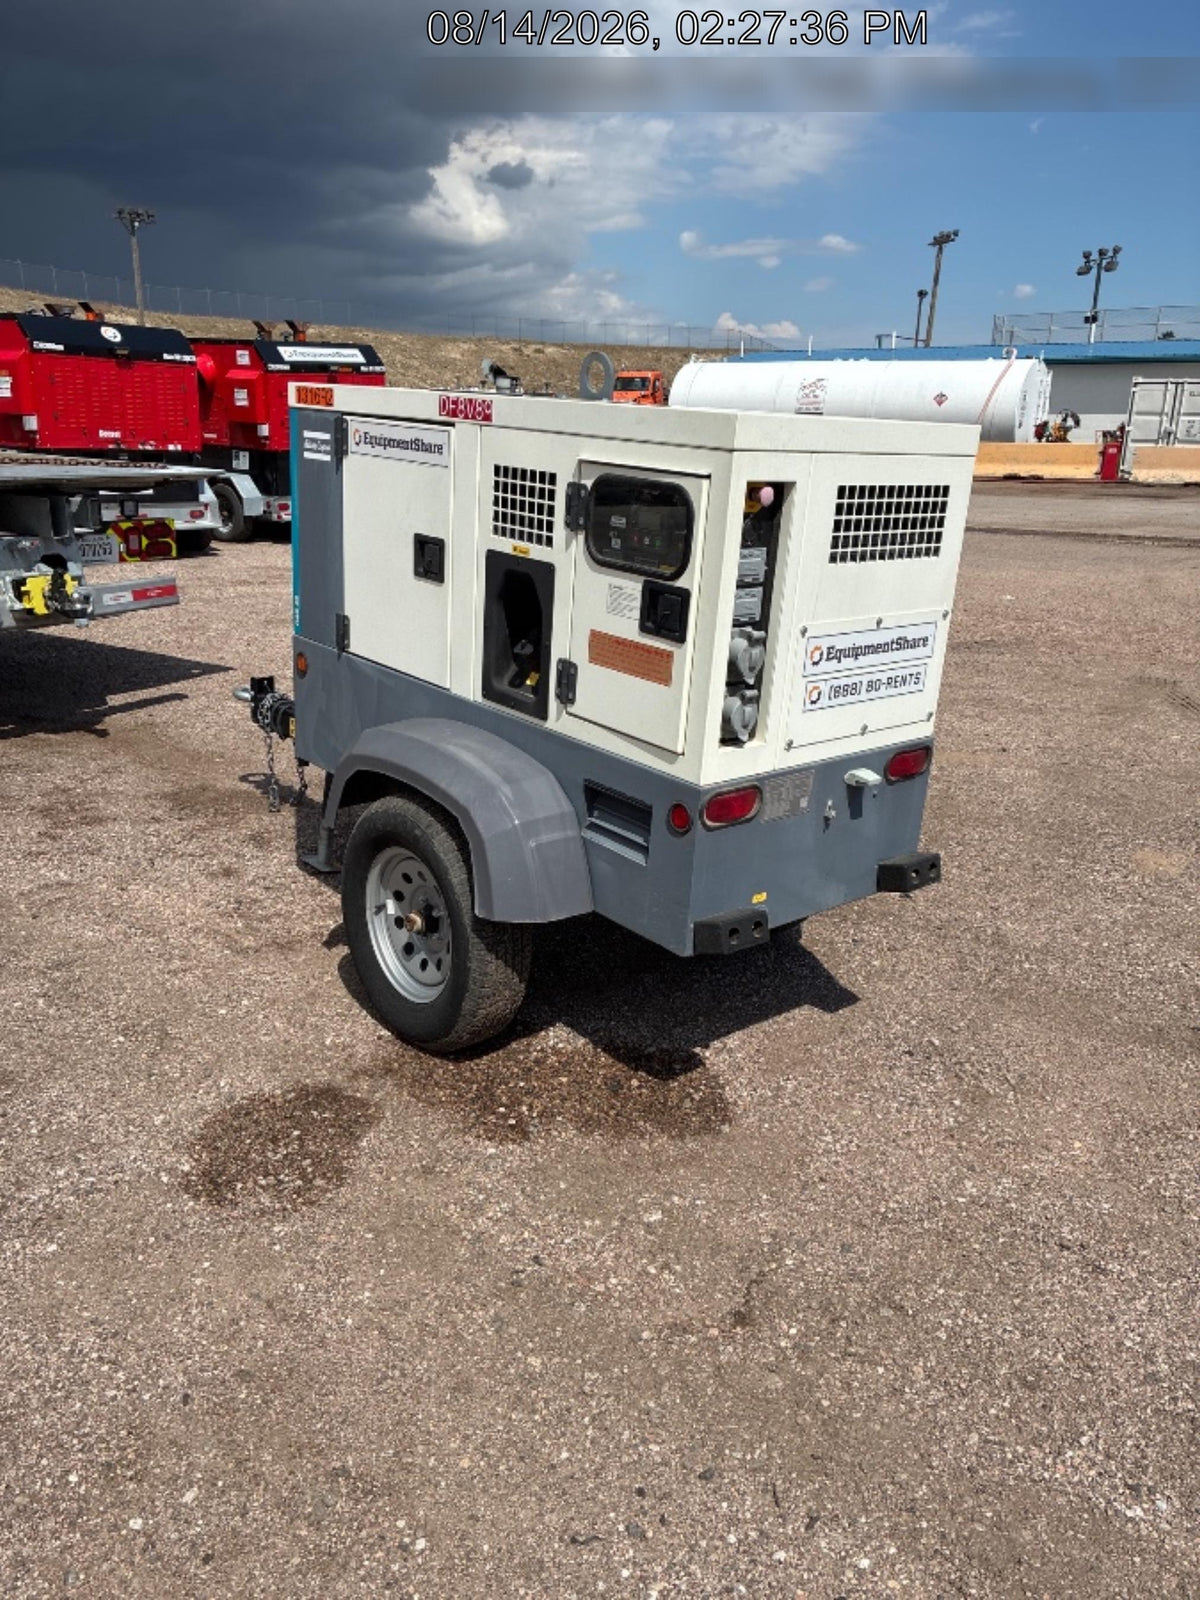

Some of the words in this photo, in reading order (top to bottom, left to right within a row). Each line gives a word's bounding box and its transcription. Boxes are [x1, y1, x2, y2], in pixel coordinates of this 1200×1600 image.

[440, 396, 492, 420] DF8V89
[363, 431, 443, 455] EquipmentShare
[825, 636, 929, 664] EquipmentShare
[828, 681, 863, 700] (888)
[866, 672, 922, 693] 80-RENTS
